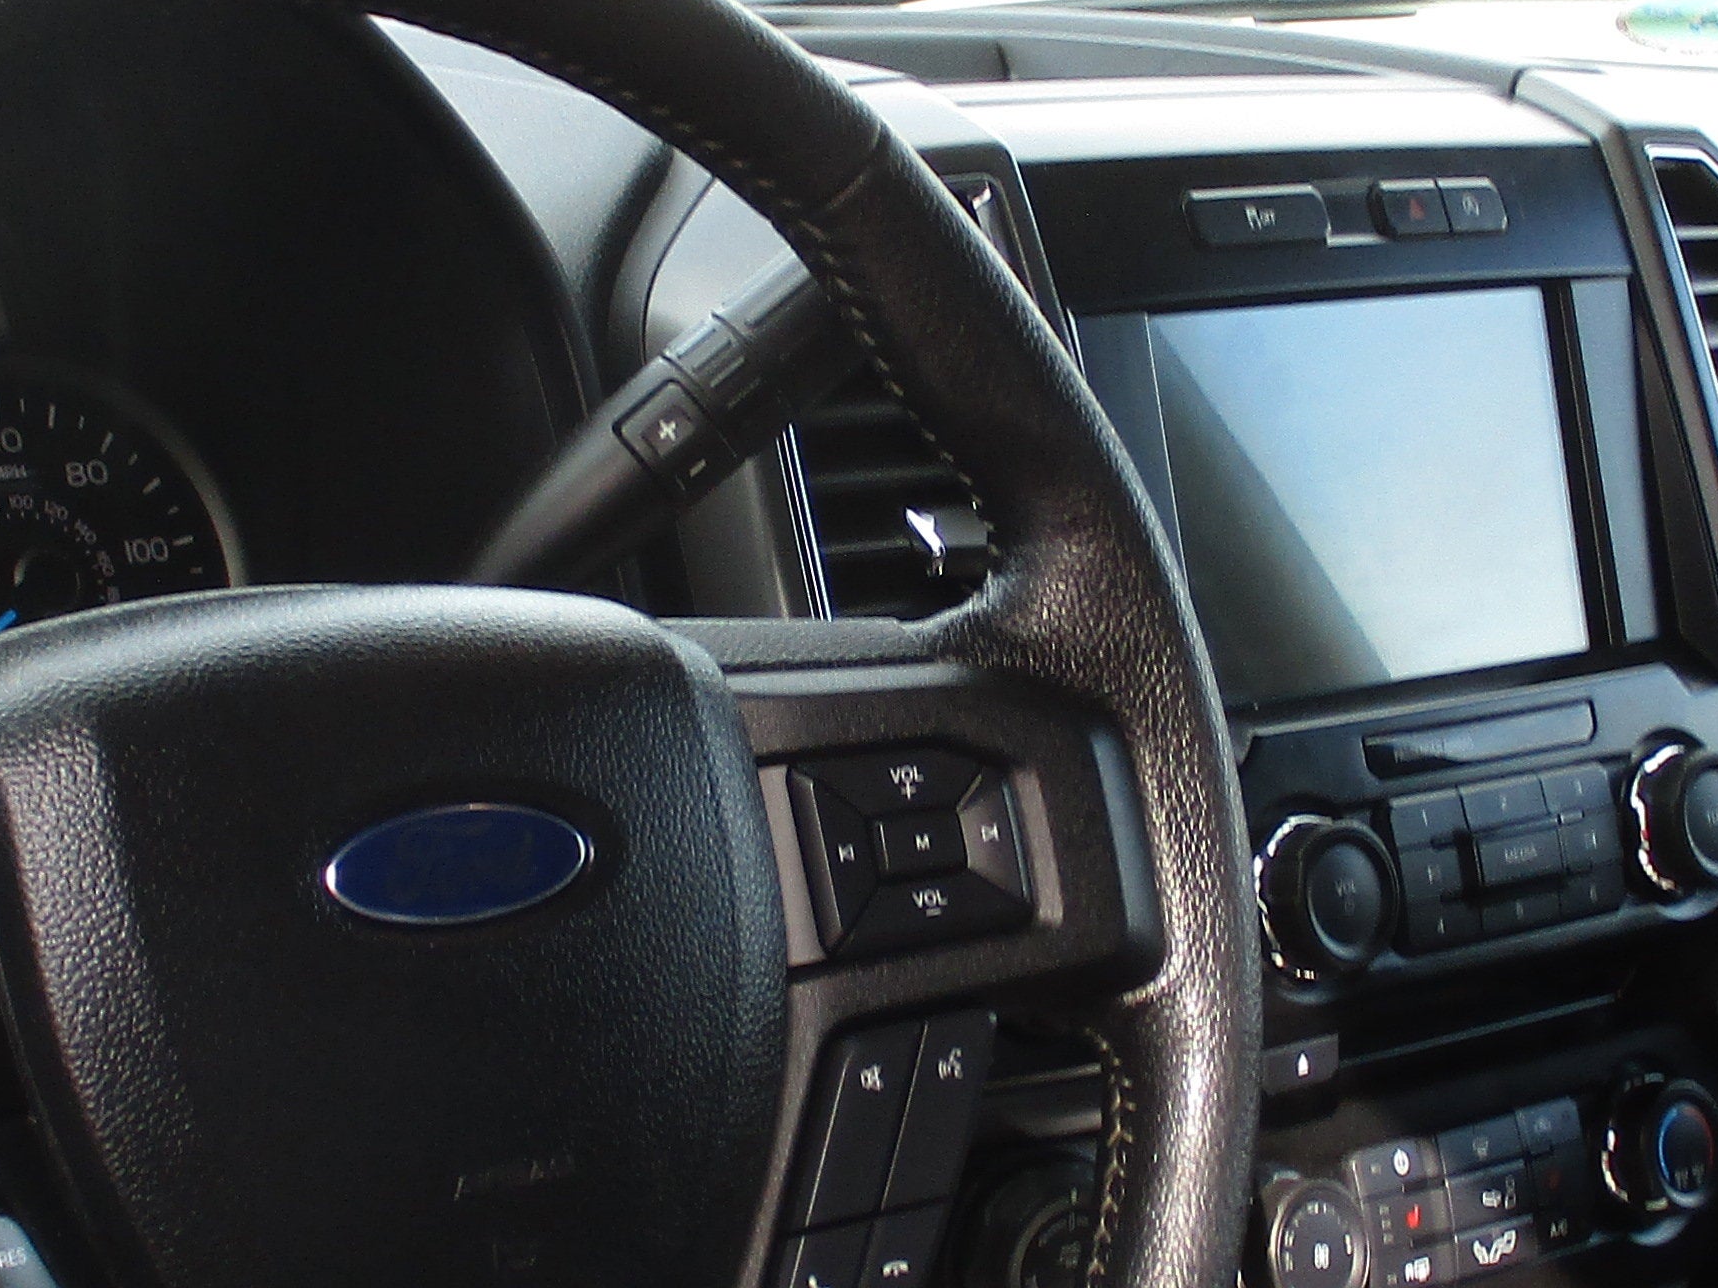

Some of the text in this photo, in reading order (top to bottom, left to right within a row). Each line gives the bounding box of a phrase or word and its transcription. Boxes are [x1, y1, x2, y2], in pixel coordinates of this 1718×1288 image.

[65, 459, 108, 488] 80
[124, 536, 168, 564] 100
[889, 765, 925, 785] VOL
[915, 834, 930, 851] M
[911, 888, 948, 907] VOL
